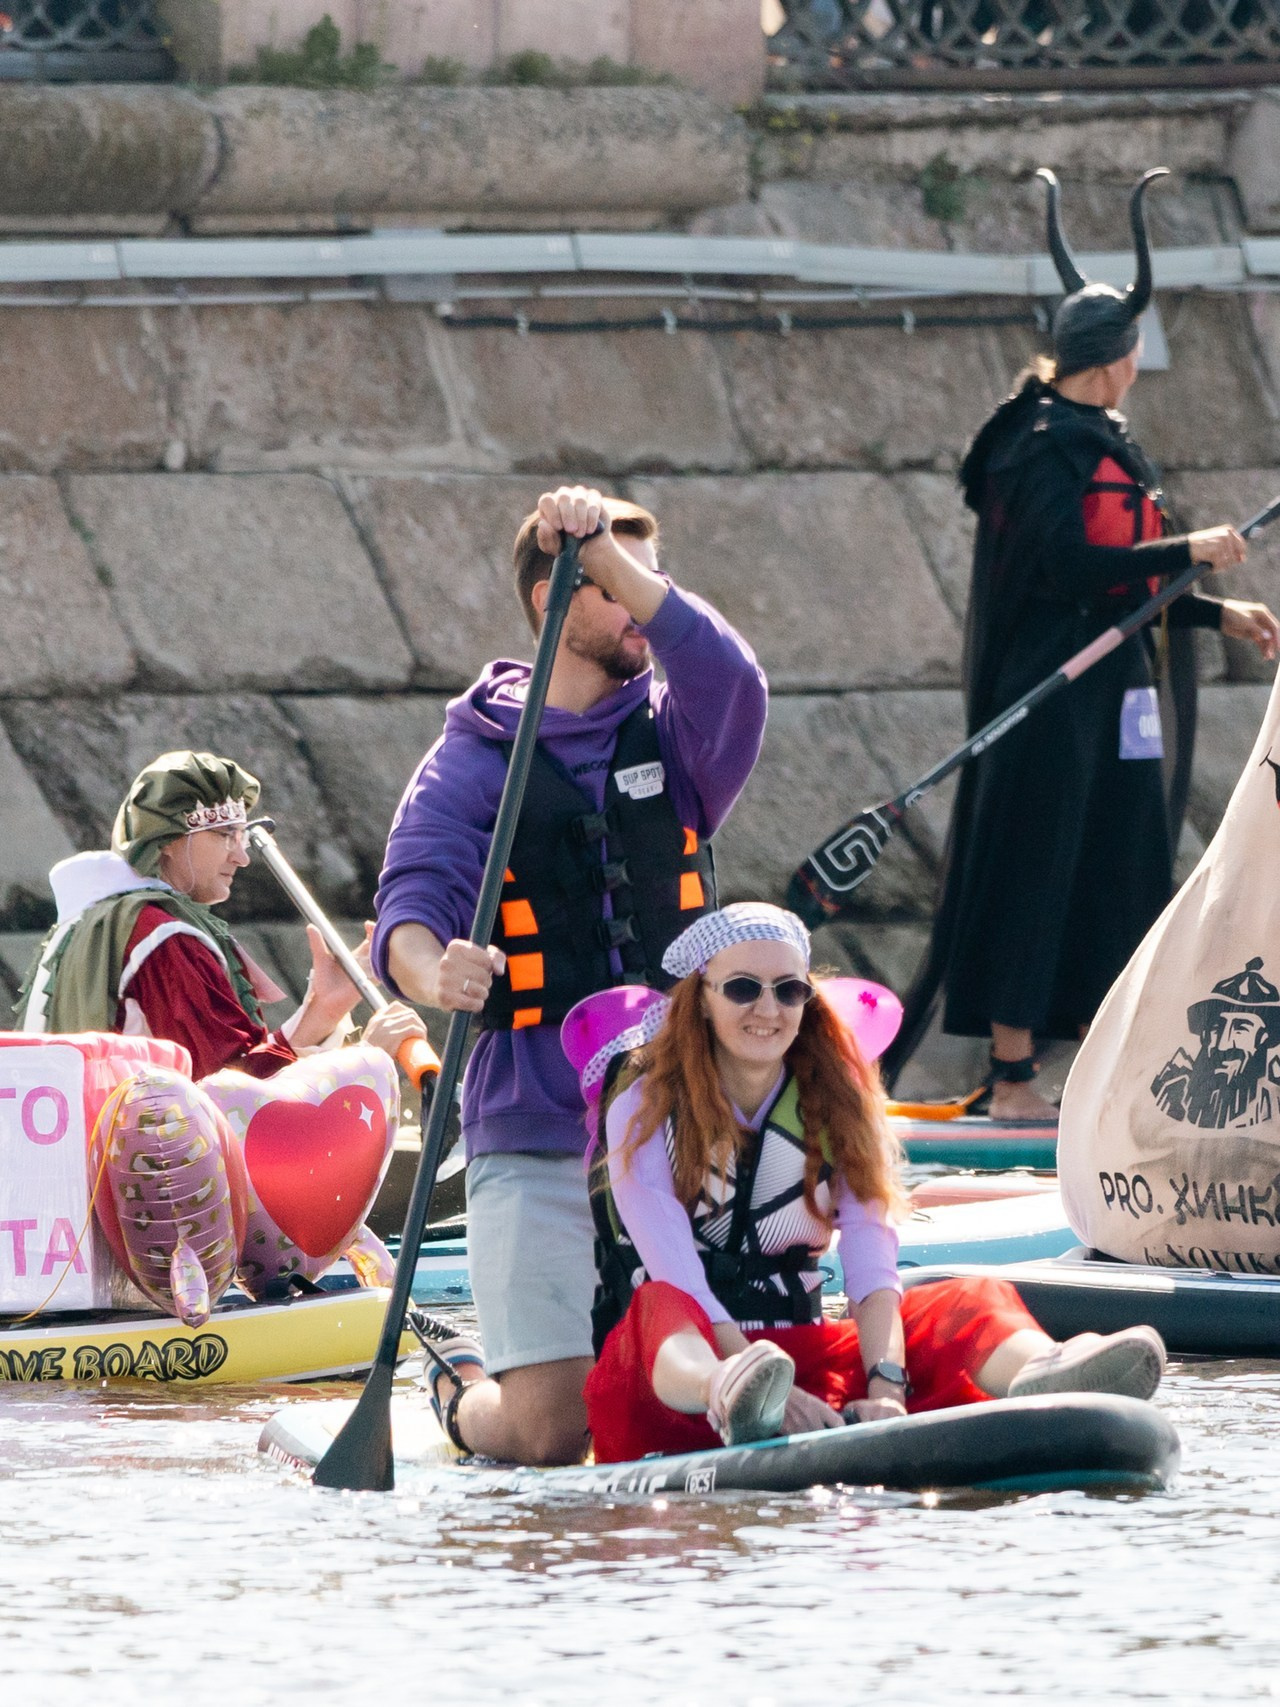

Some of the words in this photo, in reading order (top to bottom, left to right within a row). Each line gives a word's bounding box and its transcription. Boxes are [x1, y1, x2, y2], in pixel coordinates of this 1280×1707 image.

[622, 772, 639, 786] SUP
[640, 766, 662, 781] SPOT
[1099, 1172, 1164, 1219] PRO.
[74, 1333, 228, 1381] BOARD
